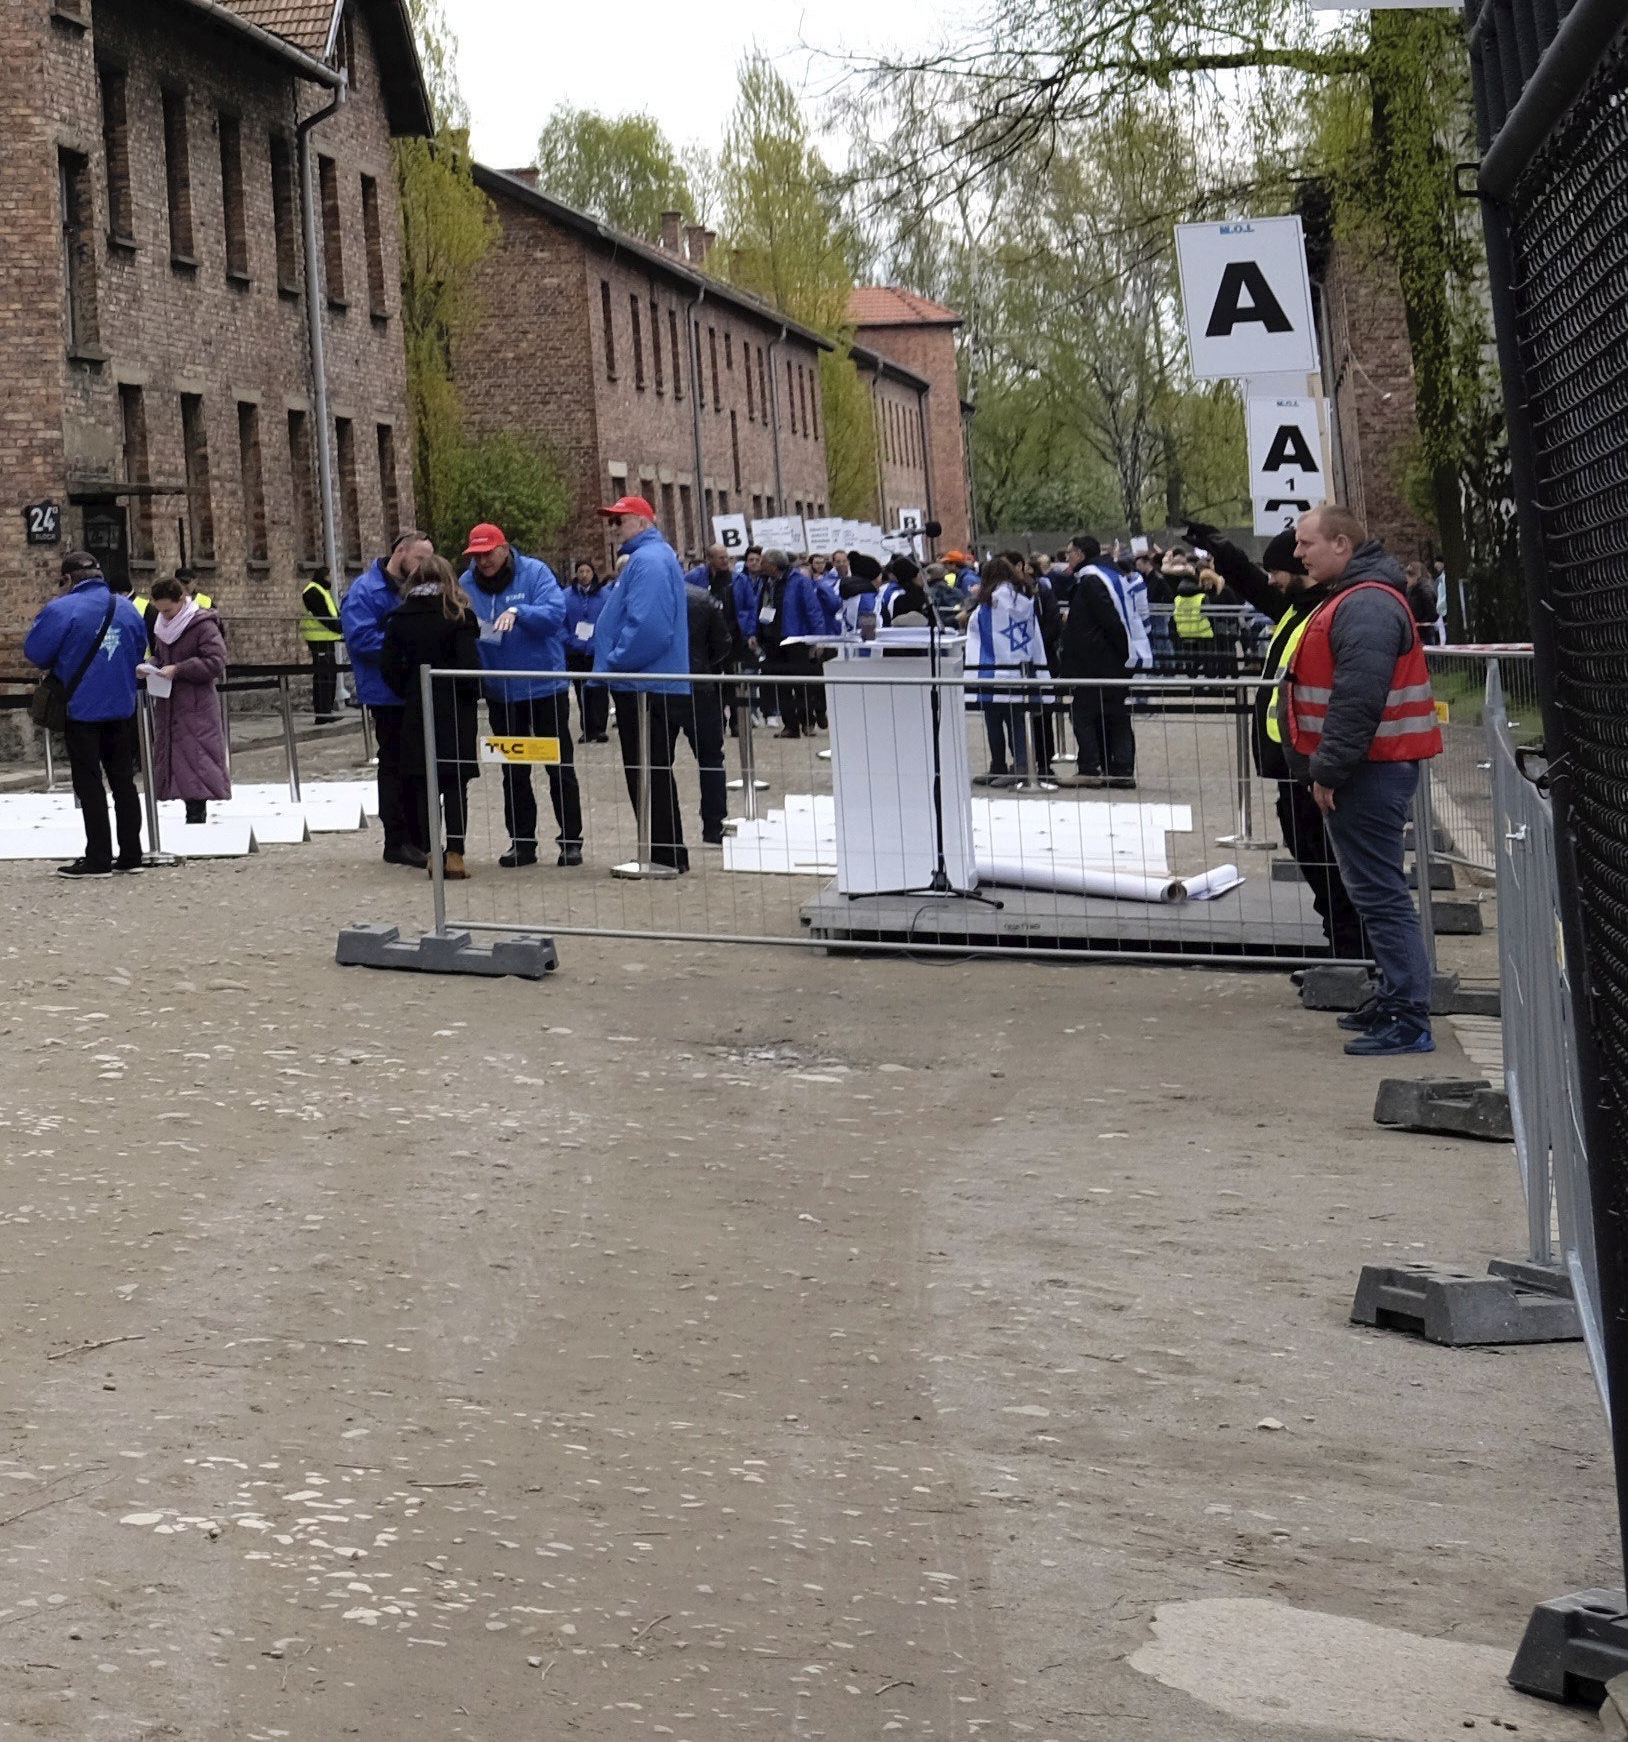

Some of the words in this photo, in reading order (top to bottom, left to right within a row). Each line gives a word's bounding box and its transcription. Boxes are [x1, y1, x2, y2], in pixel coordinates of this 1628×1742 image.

[1205, 261, 1294, 337] A
[1261, 425, 1319, 472] A
[1285, 478, 1295, 491] 1
[1284, 517, 1294, 529] 2
[721, 528, 742, 548] B
[485, 742, 524, 754] TLC
